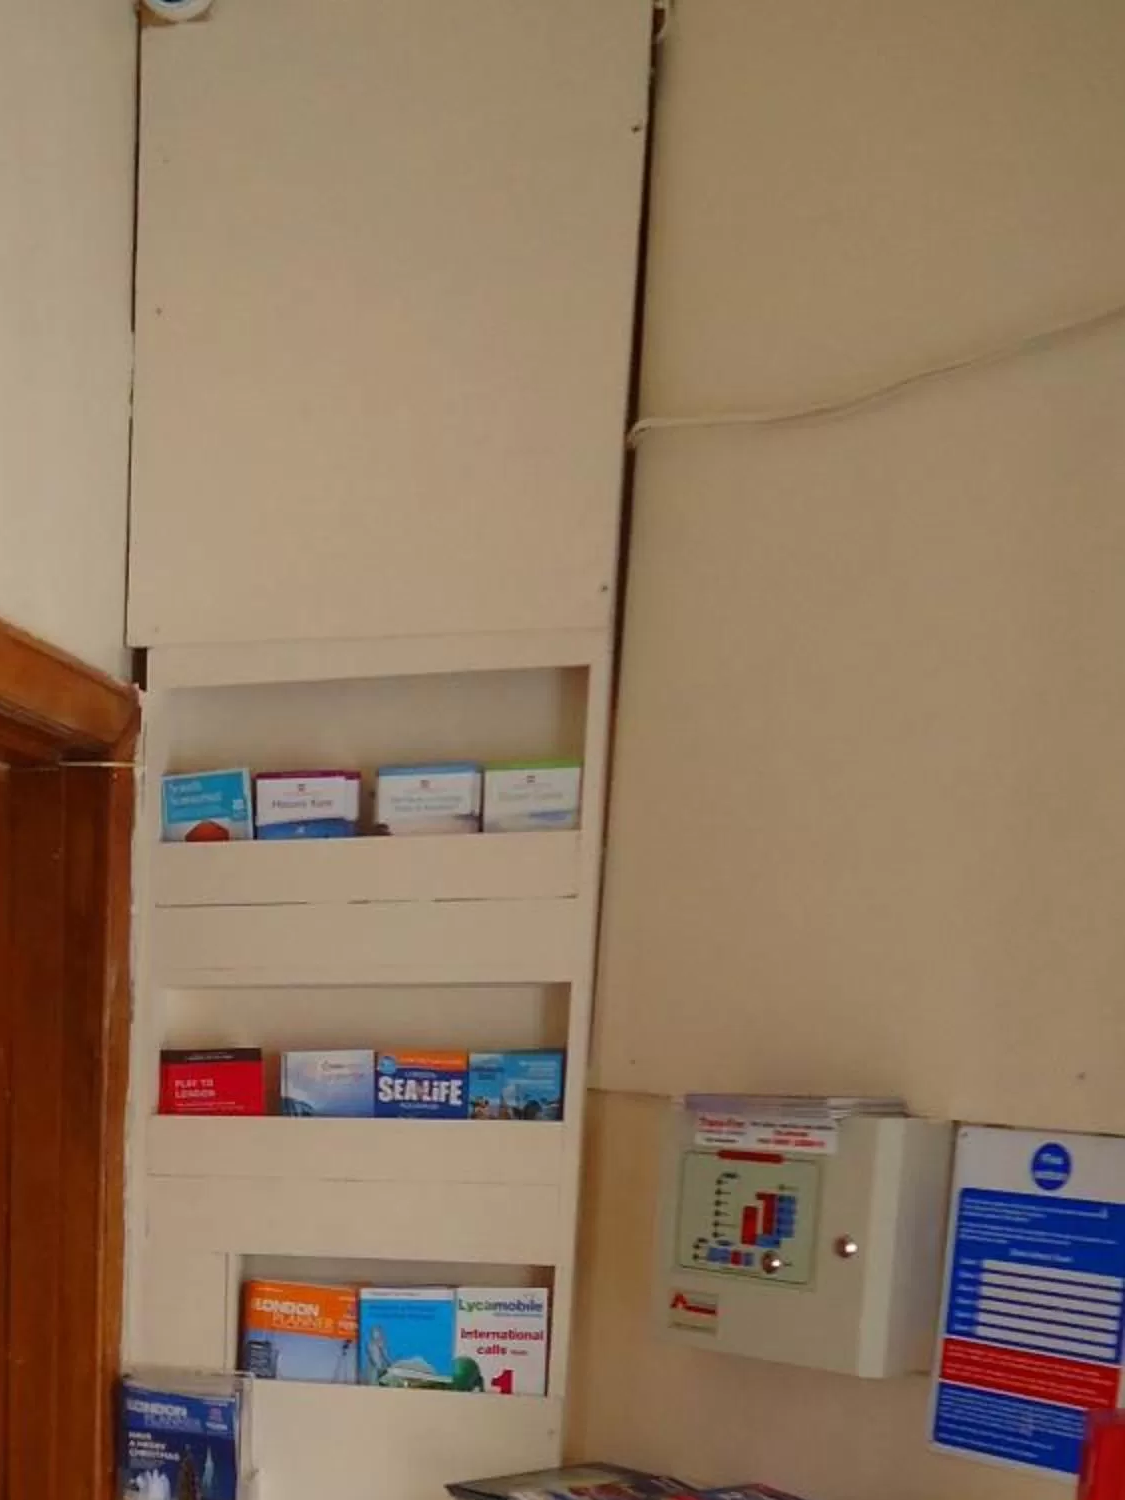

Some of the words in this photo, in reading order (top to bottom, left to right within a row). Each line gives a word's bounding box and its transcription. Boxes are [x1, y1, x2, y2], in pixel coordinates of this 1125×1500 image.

[378, 1076, 419, 1102] SEA
[254, 1298, 321, 1317] LONDON
[458, 1298, 544, 1317] Lycamobile
[460, 1327, 545, 1342] International
[476, 1343, 508, 1356] calls
[490, 1368, 515, 1395] 1
[126, 1399, 188, 1417] LONDON
